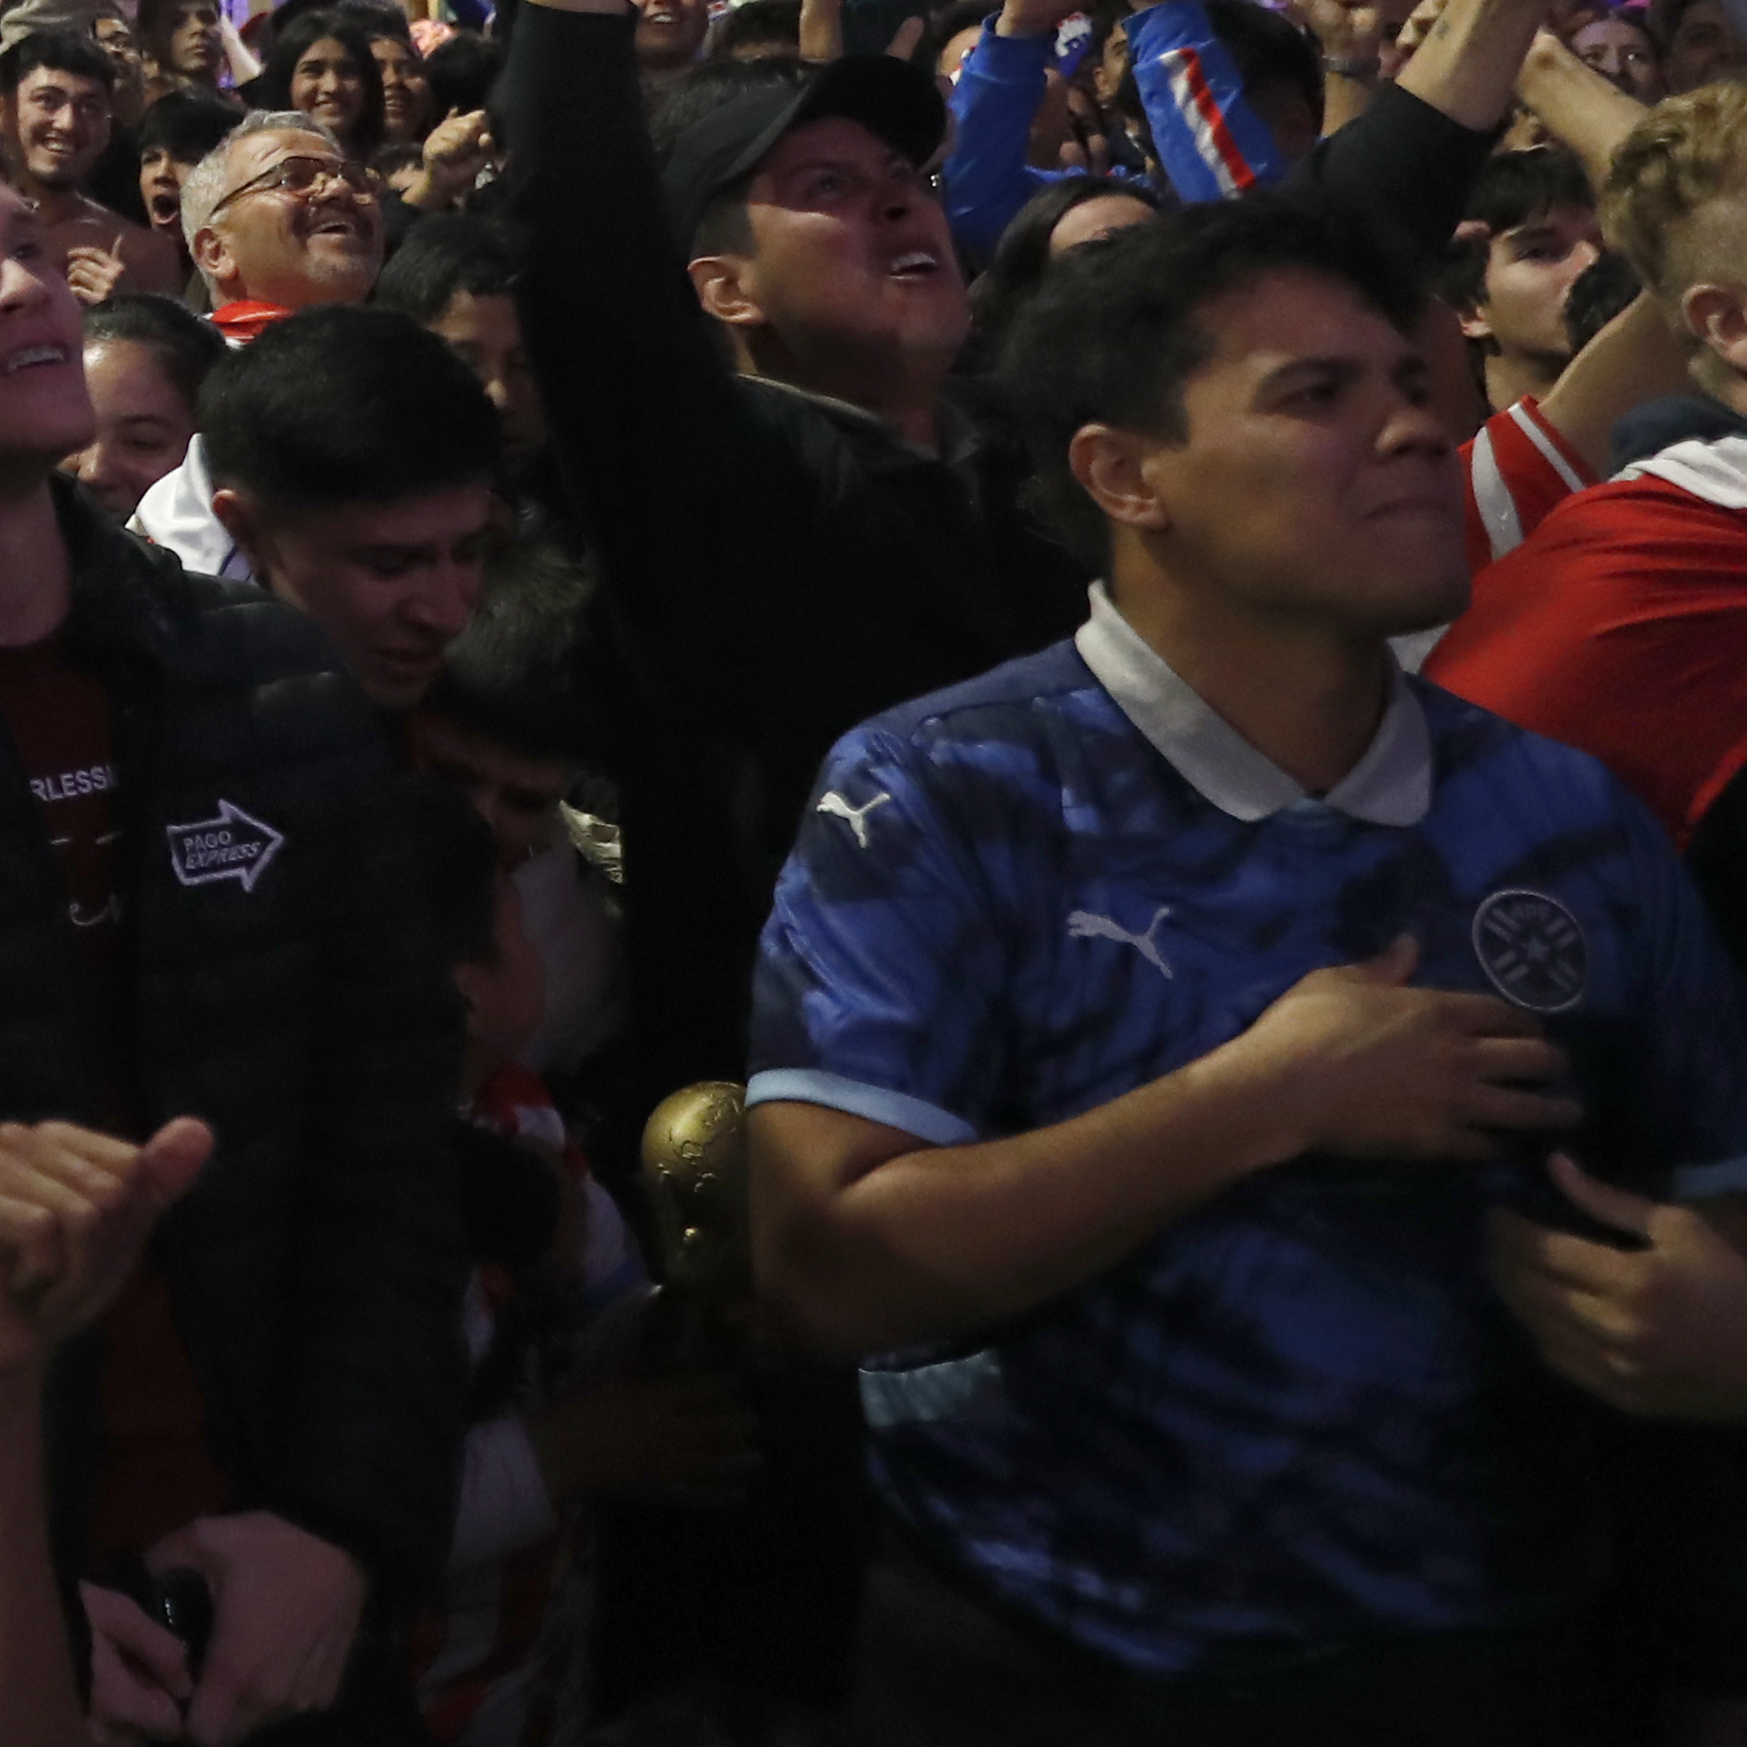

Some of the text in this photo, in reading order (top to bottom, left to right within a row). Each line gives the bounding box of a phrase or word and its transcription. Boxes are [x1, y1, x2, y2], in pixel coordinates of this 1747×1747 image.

[29, 764, 119, 802] RLESS
[183, 830, 231, 853] PAGO
[184, 841, 261, 870] EXPRESS
